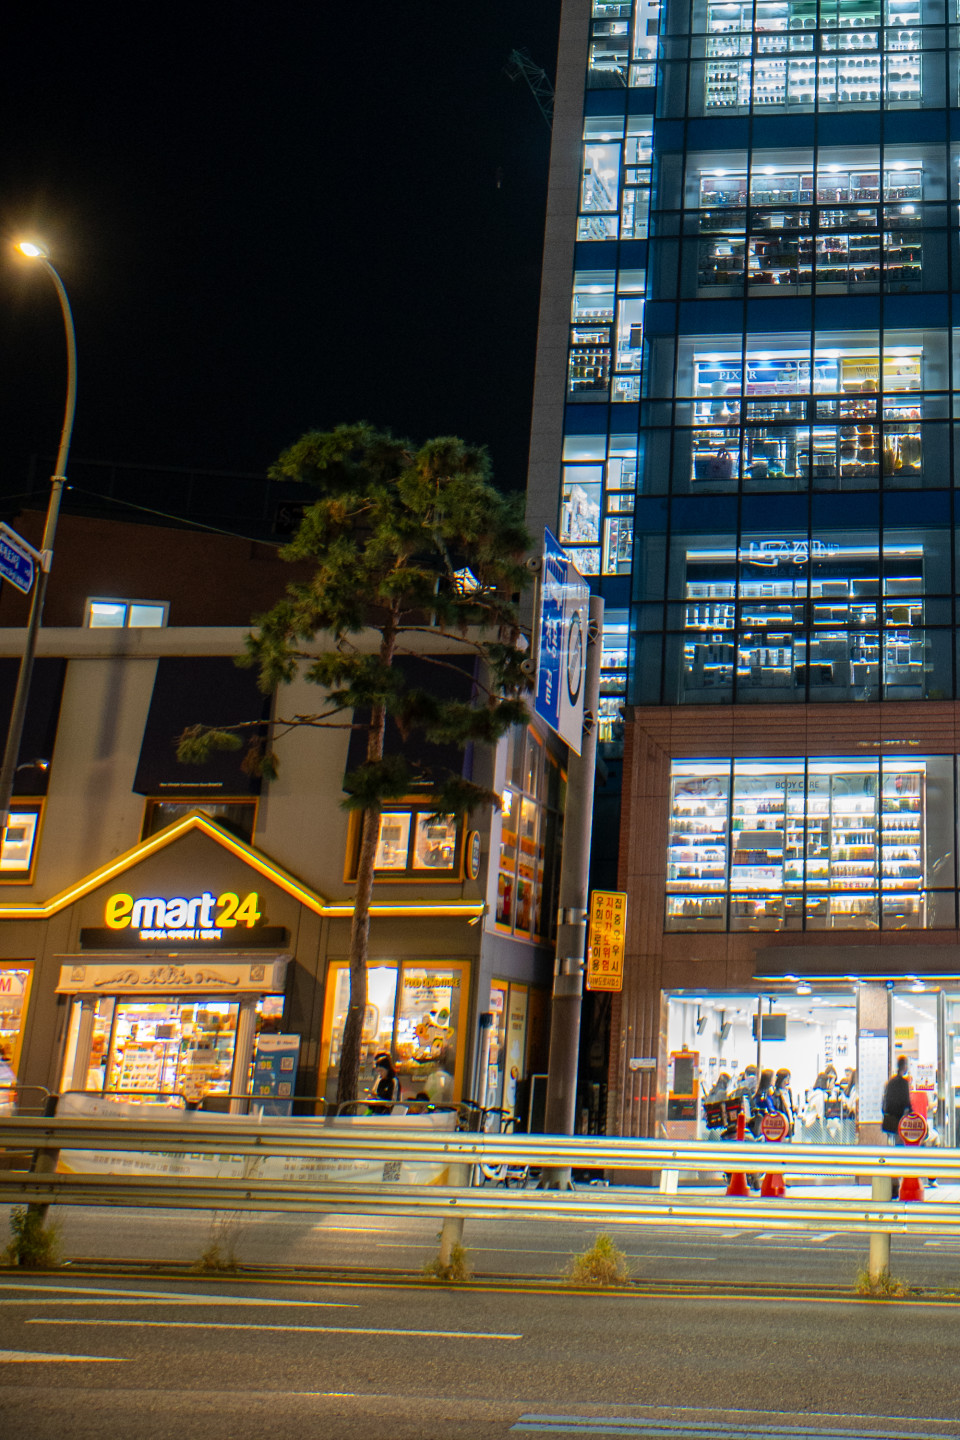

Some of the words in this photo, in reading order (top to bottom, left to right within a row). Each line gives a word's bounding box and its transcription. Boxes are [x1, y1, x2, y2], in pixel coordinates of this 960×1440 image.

[719, 371, 758, 381] PIXR
[798, 781, 820, 789] CRE
[105, 891, 261, 928] emart24
